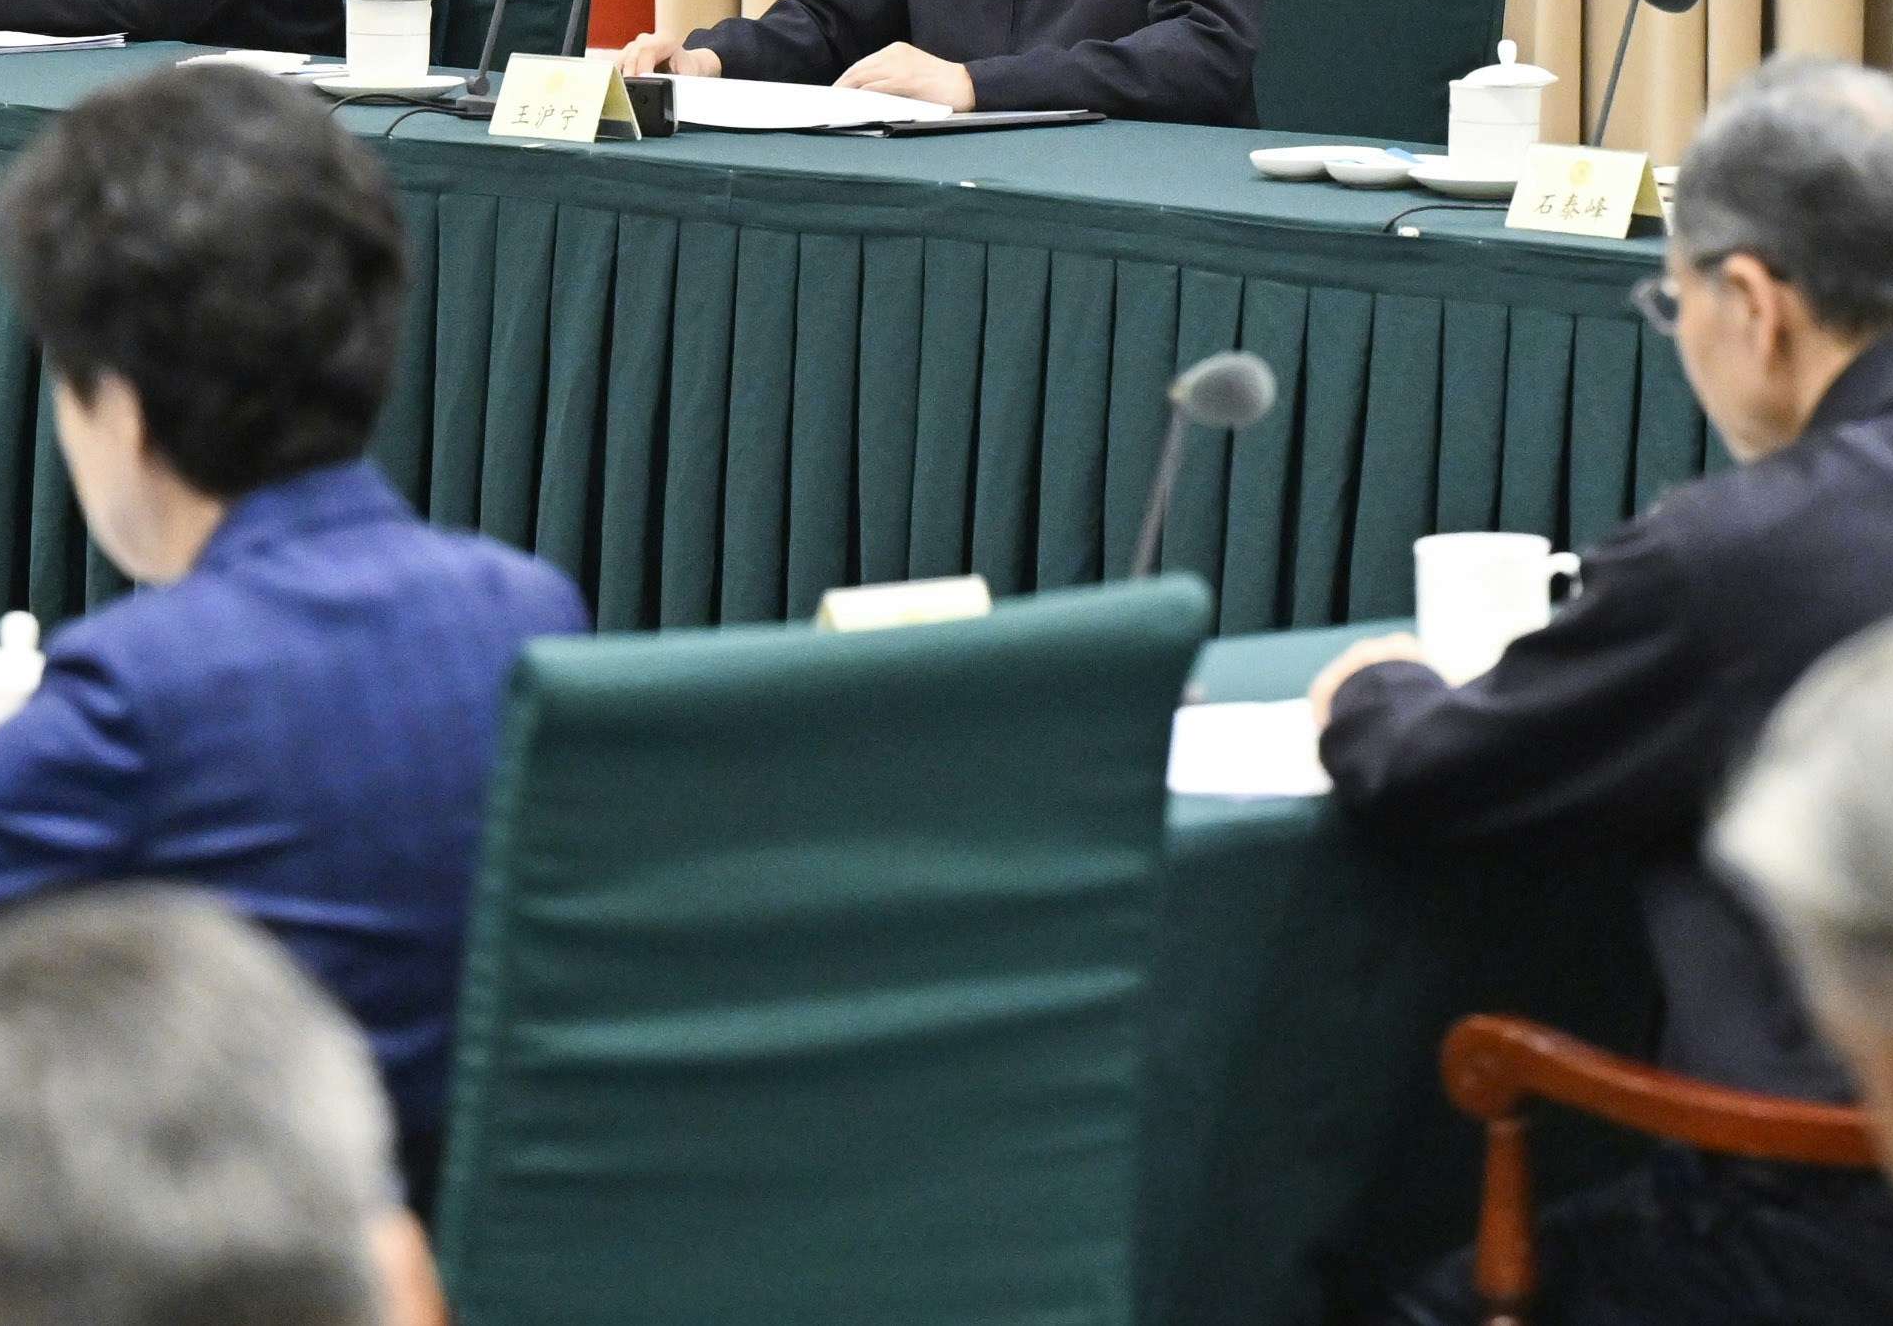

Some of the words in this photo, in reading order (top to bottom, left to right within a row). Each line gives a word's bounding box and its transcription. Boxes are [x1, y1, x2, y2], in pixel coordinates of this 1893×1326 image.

[512, 105, 578, 130] 王沪宁
[1535, 194, 1608, 219] 石泰峰
